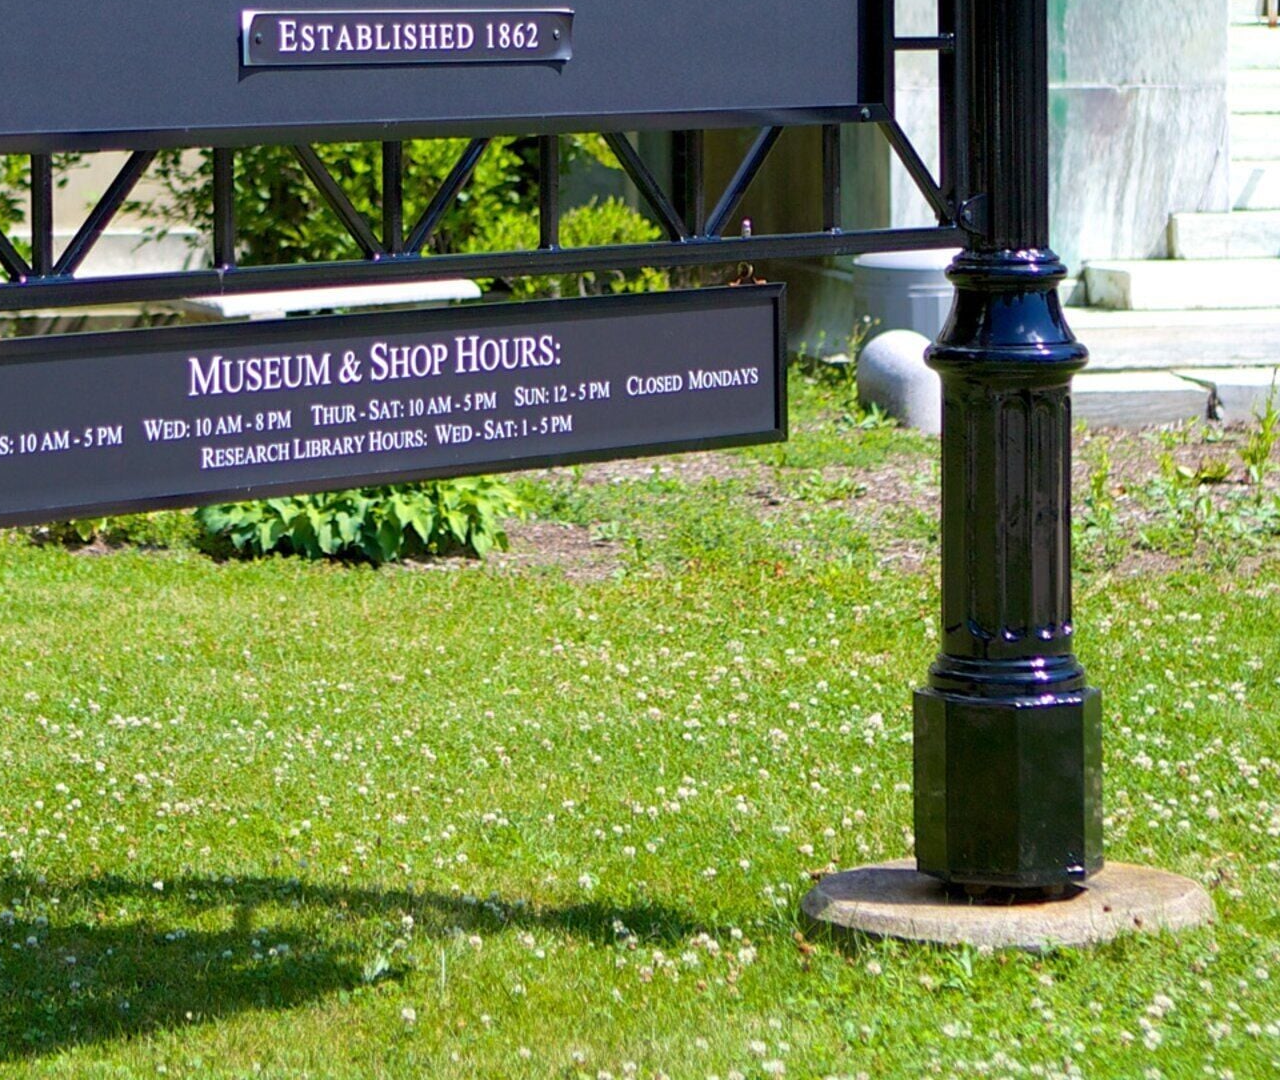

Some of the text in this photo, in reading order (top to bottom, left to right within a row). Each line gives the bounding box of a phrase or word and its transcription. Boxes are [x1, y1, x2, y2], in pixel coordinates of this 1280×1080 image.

[278, 20, 539, 52] ESTABLISHED 1862
[188, 334, 561, 396] MUSEUM & SHOP HOURS:
[19, 433, 37, 453] 10
[40, 430, 70, 451] AM
[84, 428, 93, 448] 5
[96, 425, 123, 446] PM
[143, 418, 191, 441] WED:
[195, 417, 212, 437] 10
[215, 414, 242, 435] AM
[255, 412, 265, 431] 8
[267, 410, 292, 430] PM
[310, 404, 357, 426] THUR
[368, 399, 405, 421] SAT:
[409, 398, 425, 417] 10
[426, 395, 452, 415] AM
[463, 393, 472, 412] 5
[474, 391, 497, 411] PM
[514, 385, 550, 407] SUN:
[553, 384, 568, 403] 12
[578, 383, 586, 401] 5
[589, 380, 610, 400] PM
[626, 374, 683, 396] CLOSED
[688, 367, 759, 390] MONDAYS
[201, 442, 290, 469] RESEARCH
[293, 434, 366, 460] LIBRARY
[368, 429, 428, 452] HOURS:
[434, 423, 473, 444] WED
[483, 419, 518, 440] SAT:
[522, 419, 528, 436] 1
[540, 416, 548, 435] 5
[551, 414, 573, 433] PM
